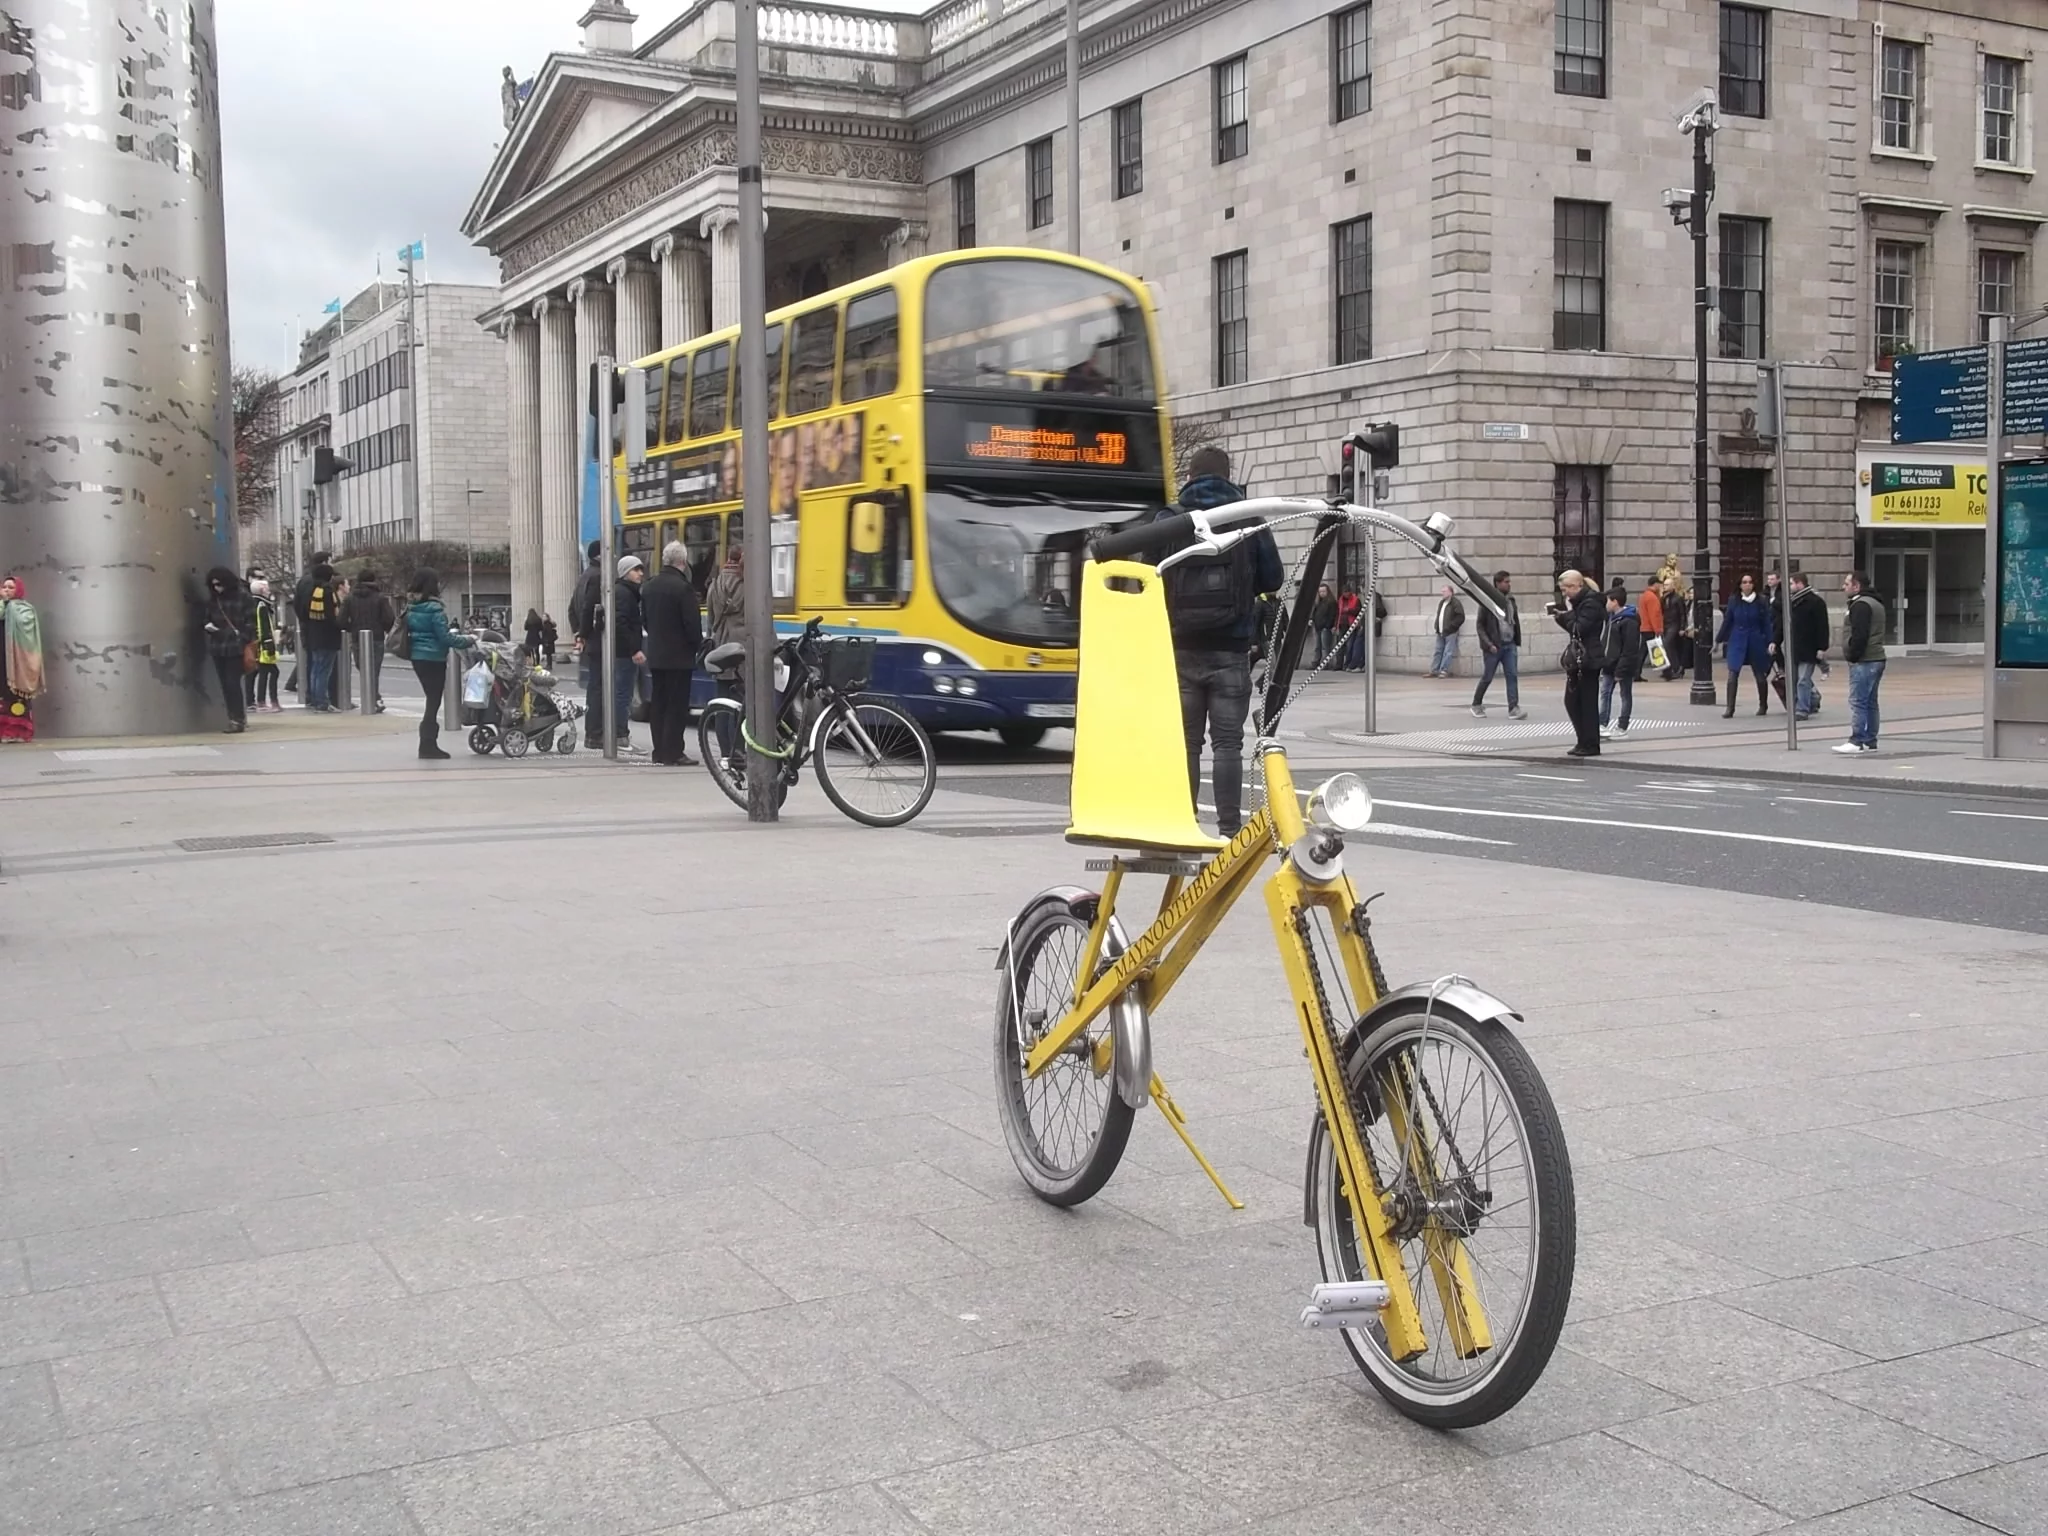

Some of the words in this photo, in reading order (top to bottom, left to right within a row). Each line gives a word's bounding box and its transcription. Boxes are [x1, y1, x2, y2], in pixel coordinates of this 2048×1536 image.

[2007, 361, 2038, 369] Amharclann
[2014, 417, 2029, 425] Hugh
[1914, 469, 1943, 477] PARIBAS
[1884, 495, 1895, 508] 01
[1900, 495, 1941, 509] 6611233
[1113, 809, 1268, 984] MAYNOOTHBIKE.COM
